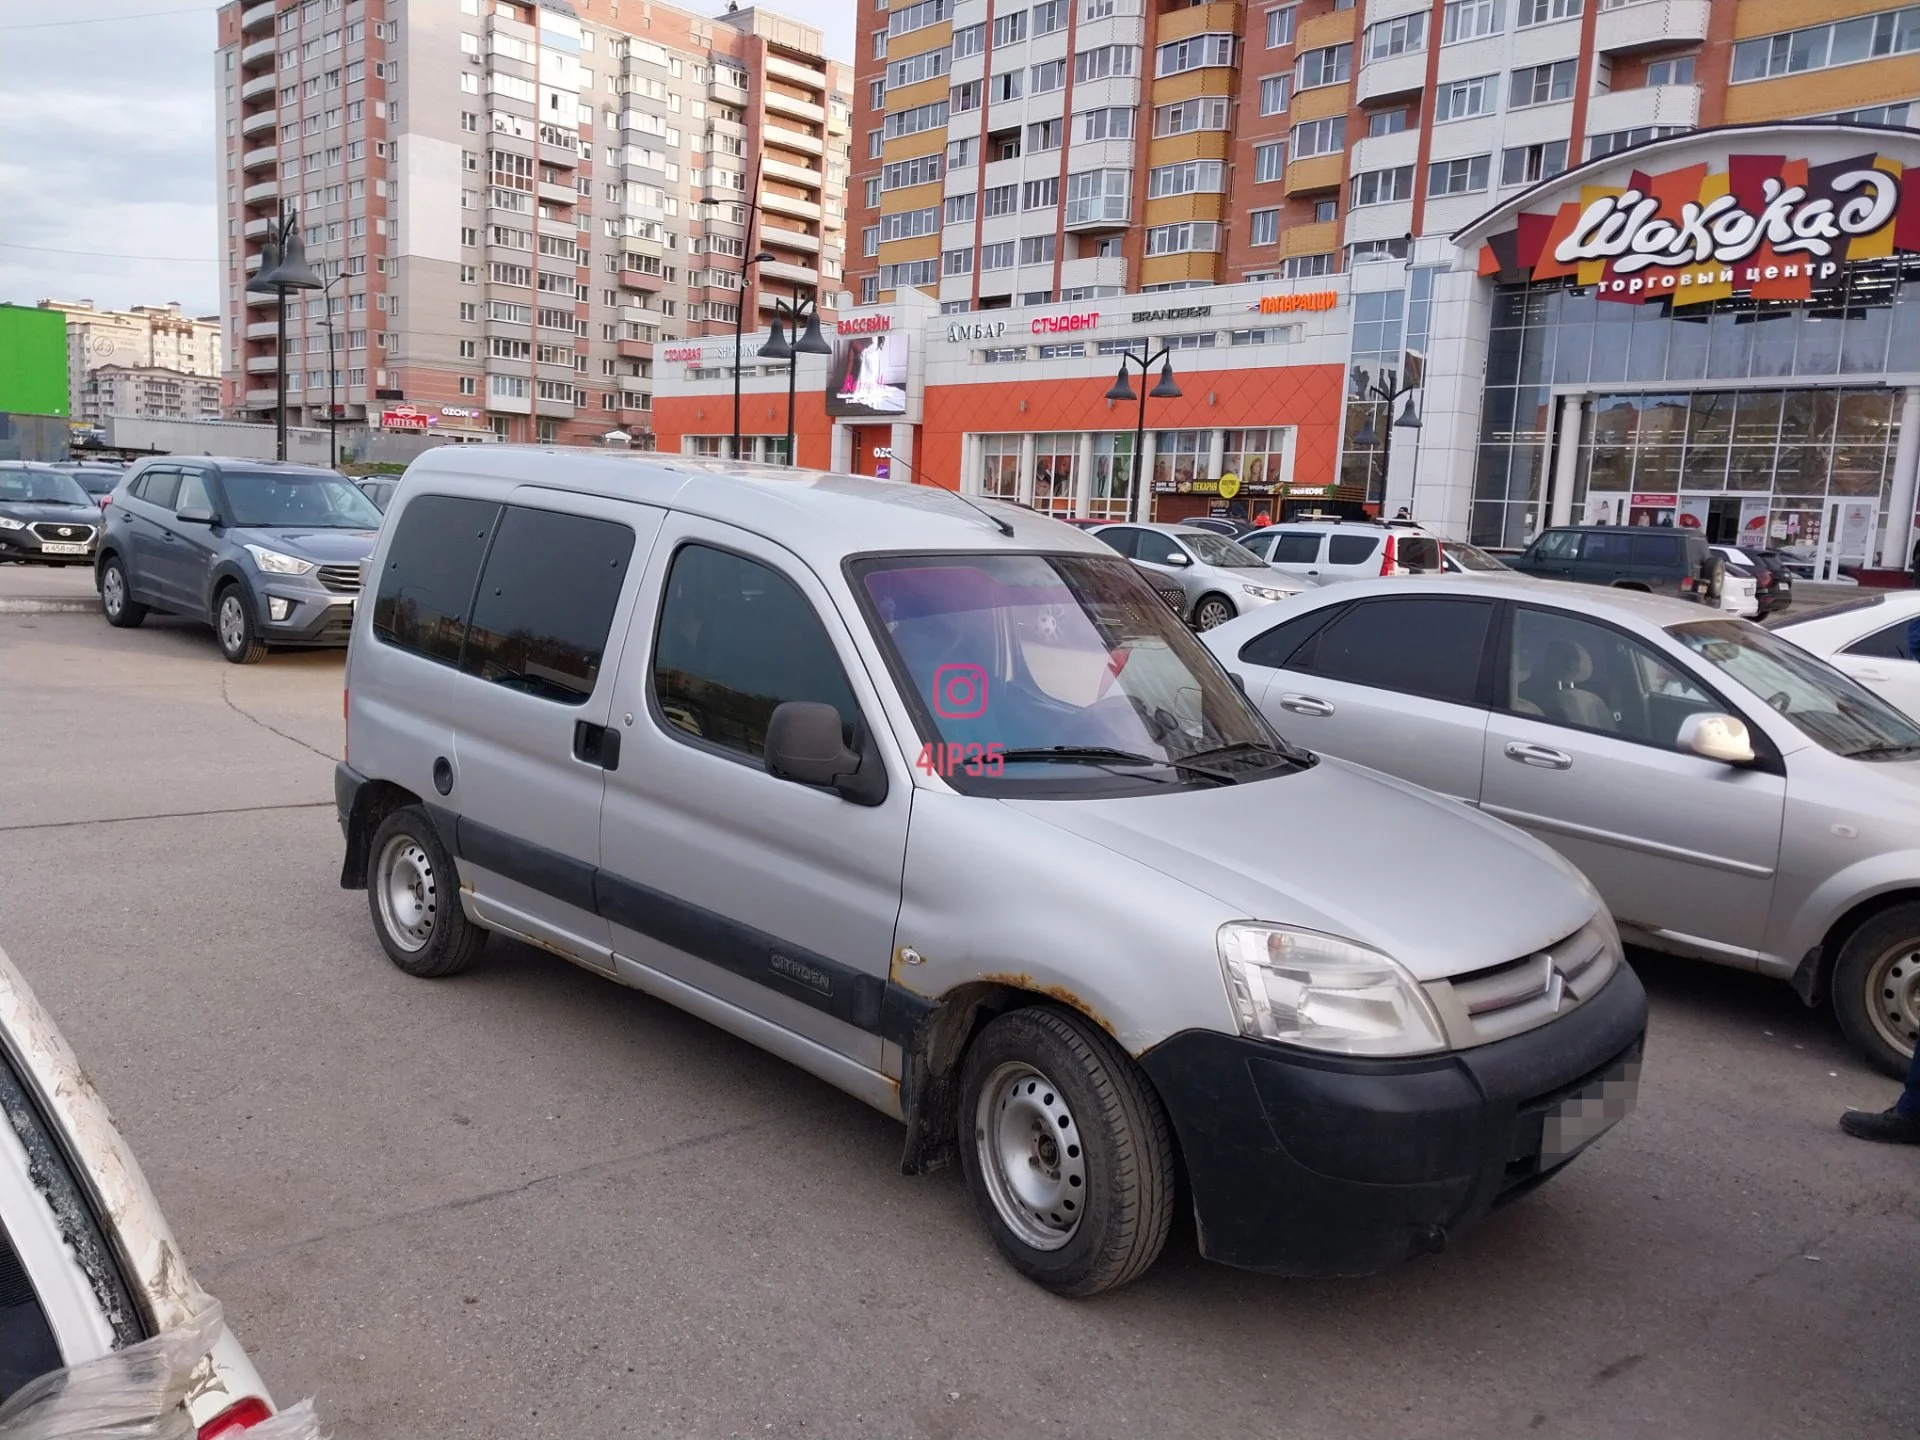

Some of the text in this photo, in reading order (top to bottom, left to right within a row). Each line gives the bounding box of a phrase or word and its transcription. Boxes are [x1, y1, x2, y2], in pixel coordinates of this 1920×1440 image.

[1598, 260, 1837, 295] торговый центр
[1259, 291, 1337, 314] ПАПАРАЦЦИ
[837, 313, 892, 335] БАССЕЙН
[947, 321, 1007, 342] АМБАР
[441, 407, 469, 417] OZON
[386, 418, 425, 428] АПТЕКА
